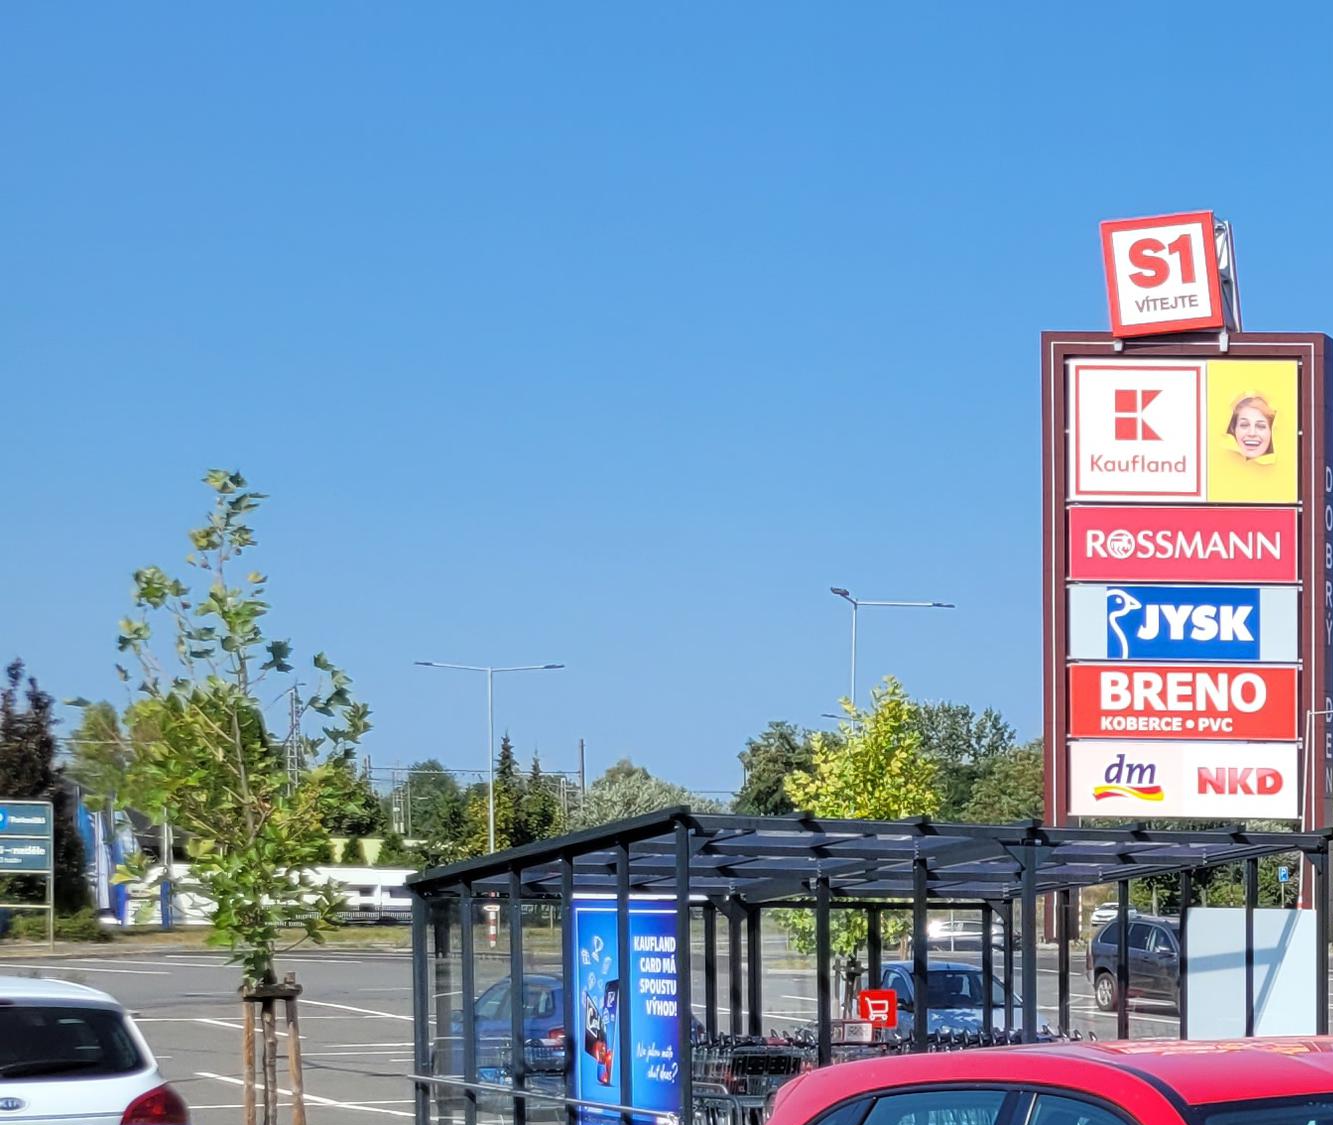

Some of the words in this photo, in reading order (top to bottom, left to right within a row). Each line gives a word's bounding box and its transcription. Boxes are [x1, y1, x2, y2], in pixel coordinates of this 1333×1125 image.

[1128, 234, 1196, 288] S1
[1135, 294, 1199, 313] VÍTEJTE
[1090, 454, 1187, 473] Kaufland
[1086, 529, 1281, 560] ROSSMANN
[1137, 603, 1255, 642] JYSK
[1100, 671, 1267, 712] BRENO
[1100, 716, 1182, 731] KOBERCE
[1198, 717, 1233, 732] PVC
[1325, 696, 1333, 793] DEN
[1104, 754, 1156, 784] dm
[1197, 767, 1284, 795] NKD
[633, 936, 676, 952] KAUFLAND
[640, 957, 661, 973] CARD
[662, 954, 676, 974] MÁ
[639, 978, 677, 995] SPOUSTU
[646, 996, 677, 1017] VÝHOD!
